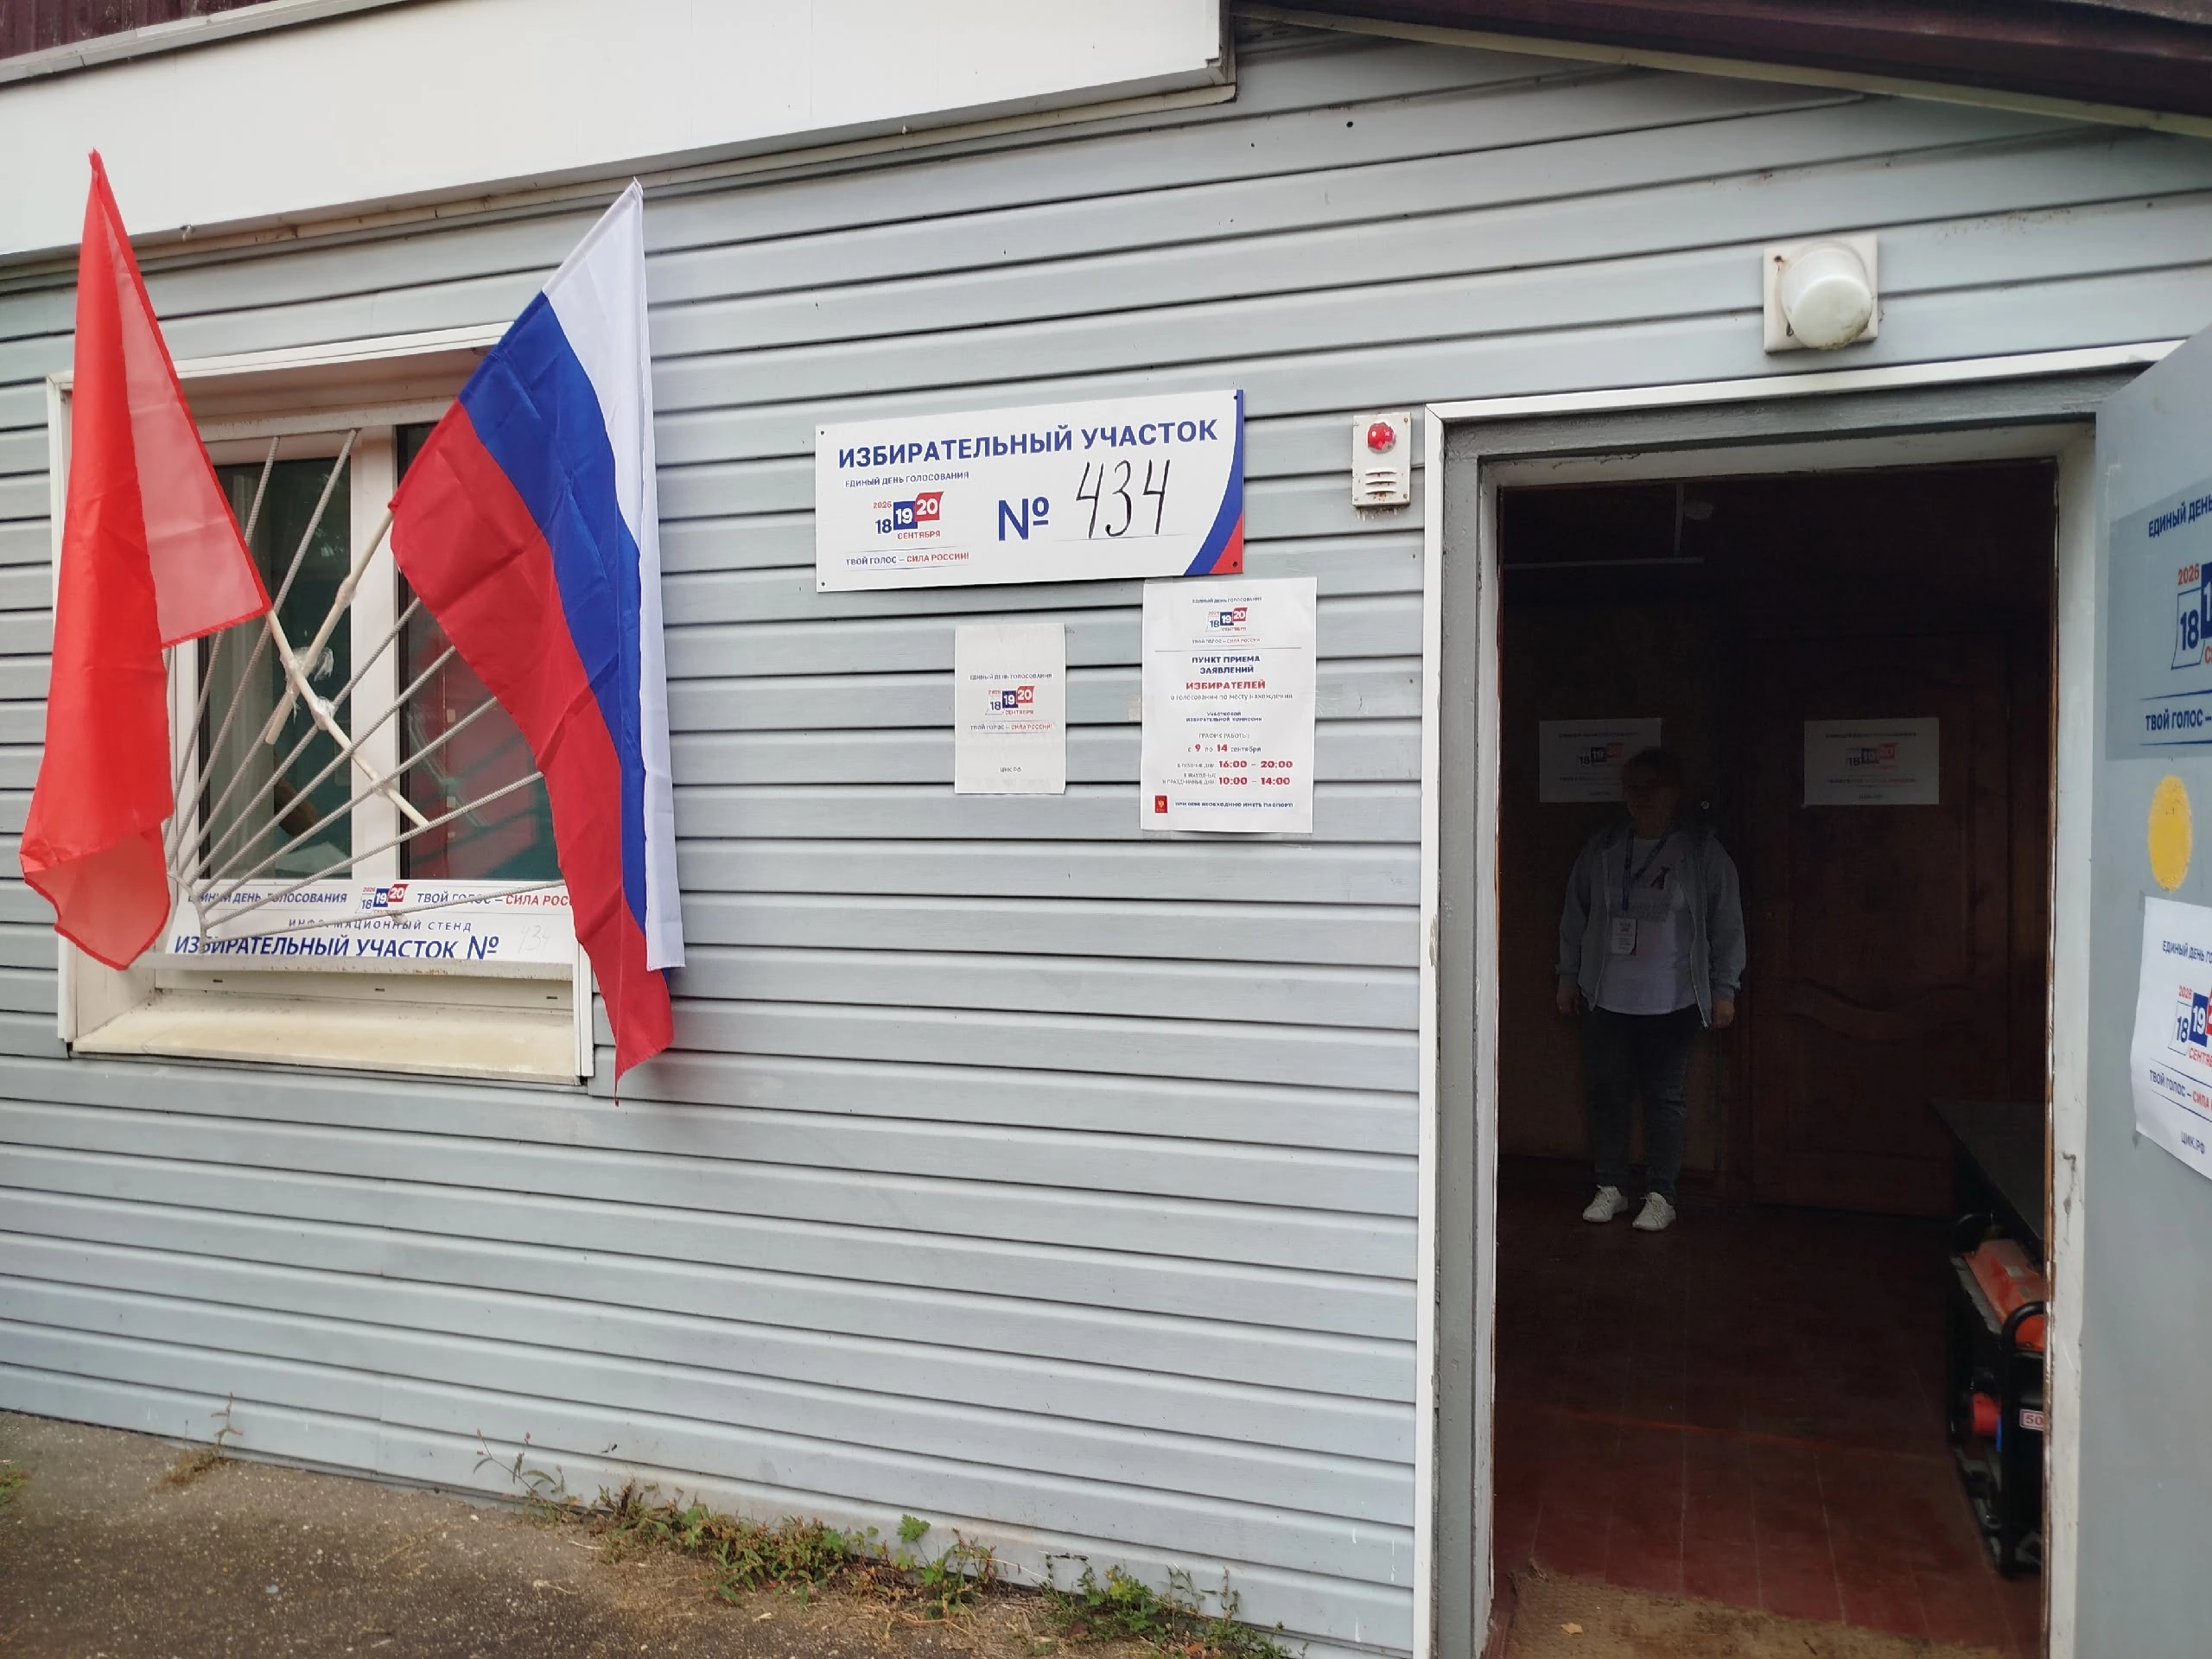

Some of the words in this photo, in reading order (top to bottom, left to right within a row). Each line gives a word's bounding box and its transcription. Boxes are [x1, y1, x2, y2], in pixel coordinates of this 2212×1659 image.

[838, 424, 1072, 469] ИЗБИРАТЕЛЬНЫЙ
[1081, 419, 1218, 451] УЧАСТОК
[845, 477, 880, 487] ЕДИНЫЙ
[881, 477, 904, 486] ДЕНЬ
[906, 471, 969, 482] ГОЛОСОВАНИЯ
[873, 500, 892, 509] 2026
[998, 496, 1050, 542] №
[1075, 459, 1171, 539] 434
[875, 518, 893, 534] 18
[895, 508, 912, 524] 19
[916, 499, 938, 516] 20
[2148, 501, 2186, 538] ЕДИНЫЙ
[897, 530, 941, 540] СЕНТЯБРЯ
[846, 556, 868, 566] ТВОЙ
[869, 556, 897, 565] ГОЛОС
[907, 554, 930, 563] СИЛА
[931, 551, 969, 562] РОССИИ!
[2177, 563, 2200, 586] 2026
[1221, 615, 1232, 624] 19
[1233, 610, 1246, 620] 20
[2180, 609, 2199, 651] 18
[2203, 581, 2212, 622] 1
[1199, 664, 1255, 675] ЗАЯВЛЕНИЙ
[1185, 678, 1266, 690] ИЗБИРАТЕЛЕЙ
[989, 701, 1001, 711] 18
[1004, 695, 1015, 706] 19
[1017, 690, 1033, 701] 20
[2145, 709, 2170, 731] ТВОЙ
[2171, 709, 2203, 728] ГОЛОС
[1194, 743, 1201, 753] 9
[1217, 743, 1228, 753] 14
[1230, 745, 1262, 753] сентября
[1218, 777, 1248, 785] 10:00
[1261, 777, 1291, 785] 14:00
[362, 899, 372, 909] 18
[376, 893, 388, 904] 19
[389, 887, 404, 899] 20
[417, 890, 448, 903] ТВОЙ
[505, 893, 539, 906] СИЛА
[289, 918, 422, 930] ИНФМАЦИОННЫЙ
[428, 922, 472, 932] СТЕНД
[356, 939, 459, 958] УЧАСТОК
[467, 936, 499, 960] №
[2163, 940, 2189, 957] ЕДИНЫЙ
[2189, 947, 2205, 962] ДЕНЬ
[2178, 985, 2193, 999] 2026
[2177, 1016, 2190, 1043] 18
[2192, 1005, 2206, 1035] 19
[2149, 1070, 2165, 1087] ТВОЙ
[2165, 1078, 2186, 1097] ГОЛОС
[2192, 1090, 2209, 1109] СИЛА
[2181, 1130, 2205, 1154] ЦИК.РФ
